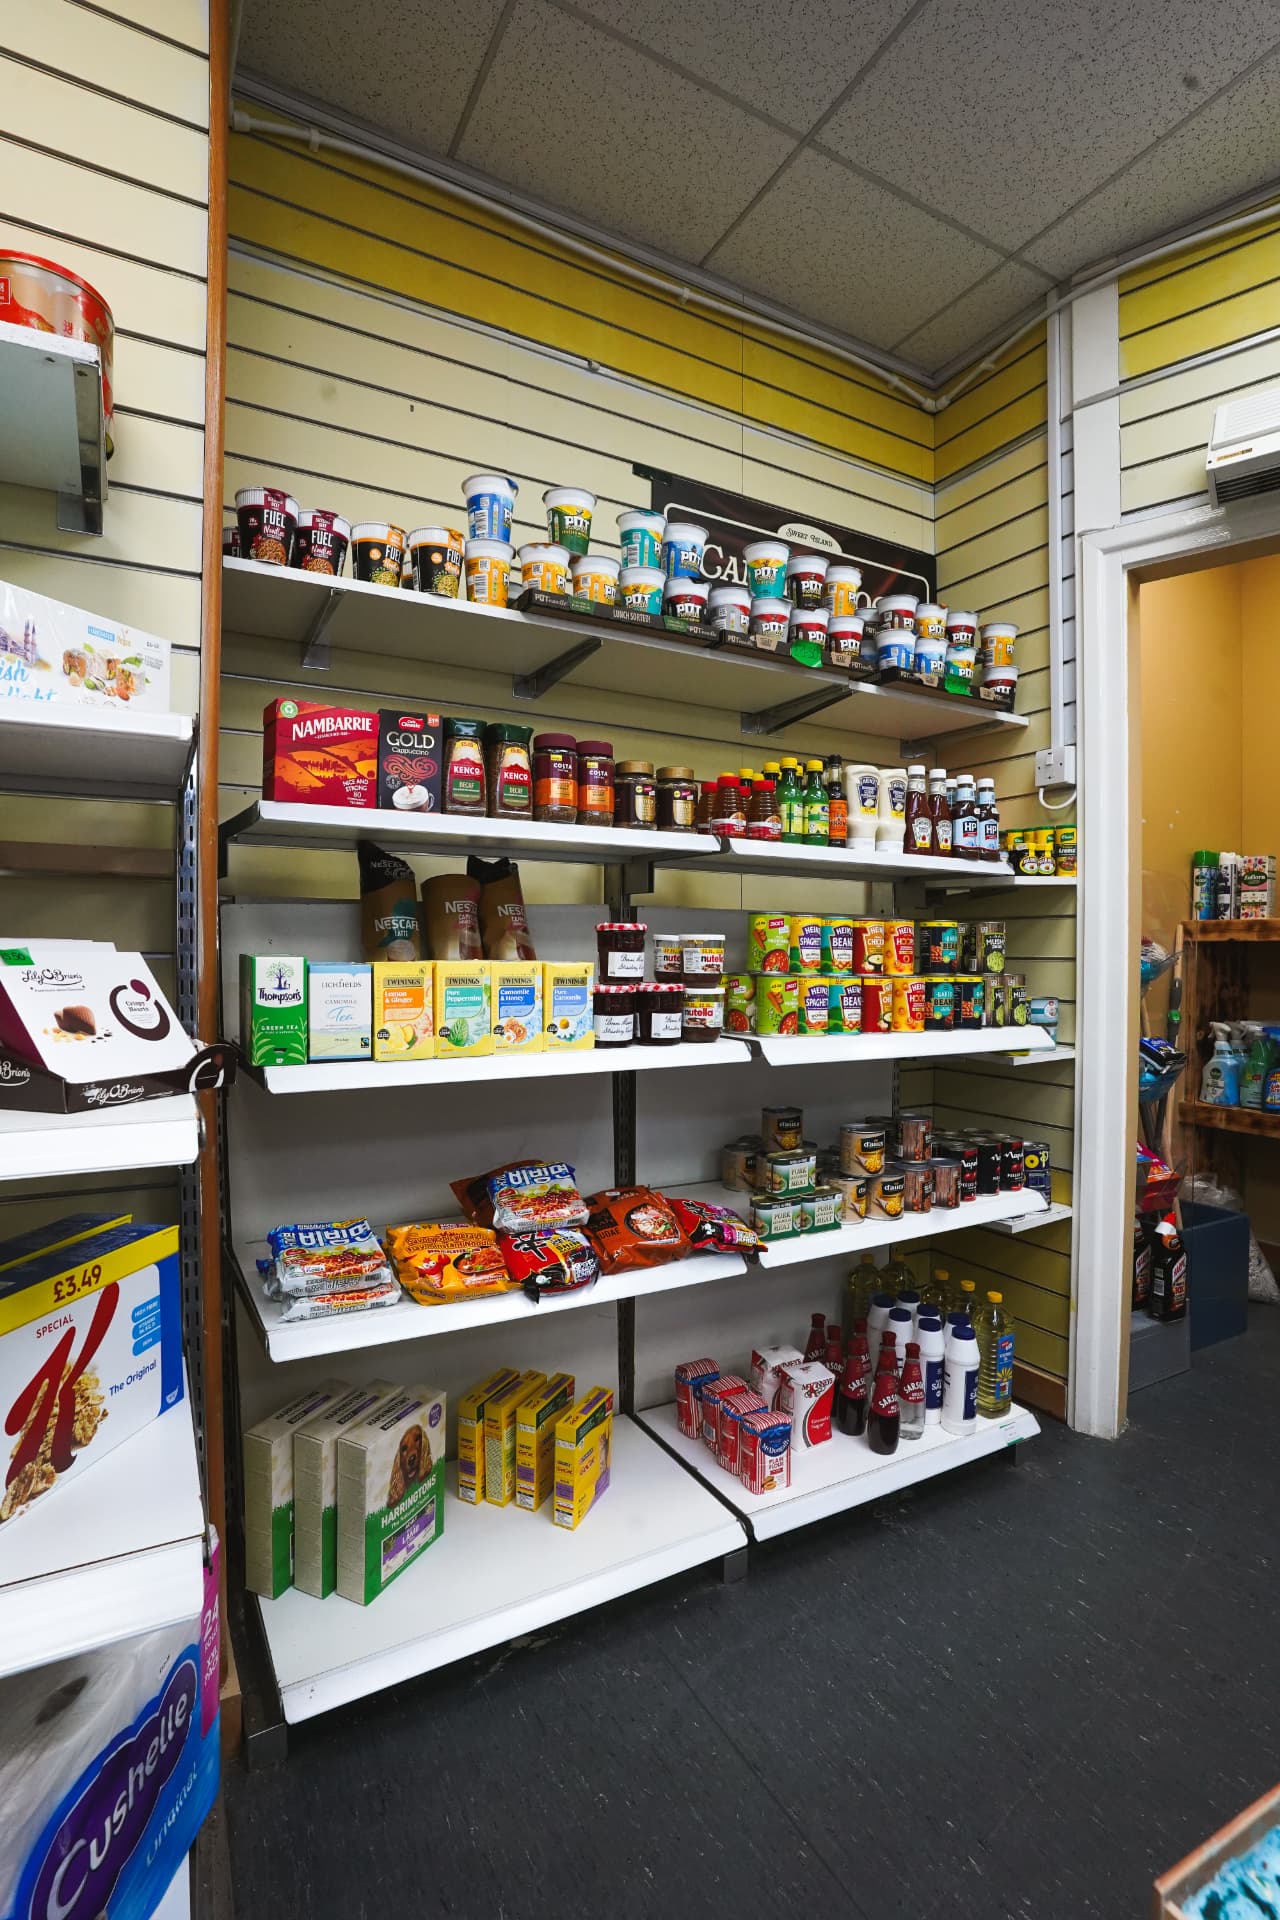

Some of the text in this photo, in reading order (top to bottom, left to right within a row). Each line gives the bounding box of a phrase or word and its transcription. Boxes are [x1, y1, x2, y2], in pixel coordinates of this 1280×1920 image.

[263, 509, 287, 528] FUEL
[564, 515, 590, 528] POT
[311, 530, 333, 547] FUEL
[786, 527, 833, 548] SWEET ISLAND
[754, 566, 779, 578] POT
[800, 580, 823, 591] POT
[625, 593, 651, 606] POT
[613, 609, 629, 620] LUNCH
[675, 602, 702, 616] POT
[761, 621, 786, 634] POT
[951, 632, 973, 642] POT
[839, 638, 861, 651] POT
[292, 716, 373, 741] NAMBARRIE
[386, 731, 435, 749] GOLD
[391, 746, 430, 756] Cappuccino
[453, 765, 481, 776] KENCO
[553, 762, 573, 770] COSTA
[503, 771, 529, 781] KENCO
[588, 769, 608, 777] COSTA
[964, 822, 977, 832] HP
[986, 825, 997, 834] HP
[502, 977, 532, 985] TWININGS
[328, 1005, 354, 1022] Tea
[684, 1007, 714, 1017] nutella
[53, 1264, 102, 1303] £3.49
[36, 1314, 74, 1339] SPECIAL
[109, 1359, 157, 1397] The Original
[381, 1474, 437, 1529] HARRINGTONS
[47, 1691, 189, 1920] Cushelle
[147, 1760, 199, 1866] Original
